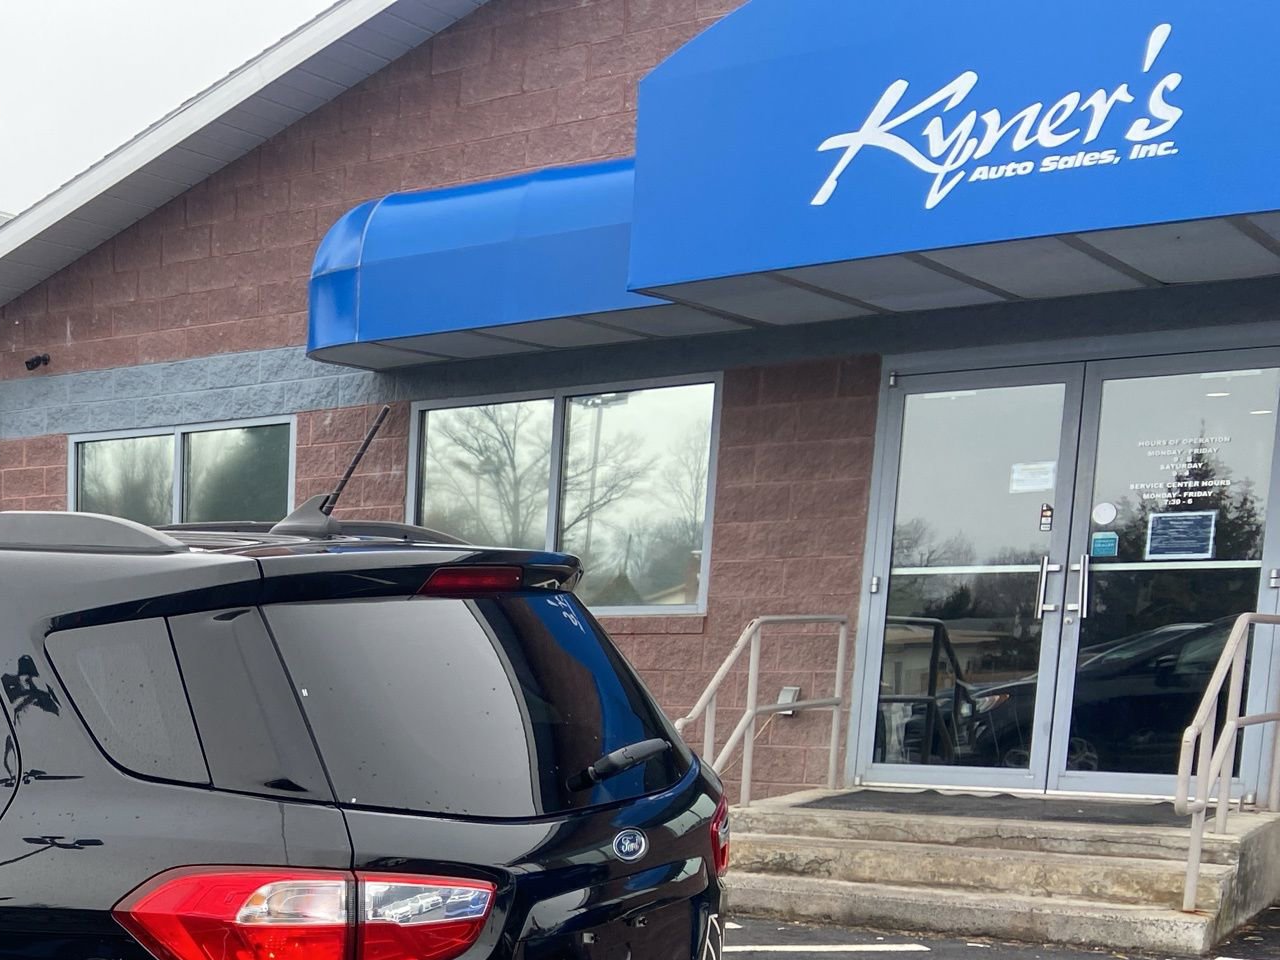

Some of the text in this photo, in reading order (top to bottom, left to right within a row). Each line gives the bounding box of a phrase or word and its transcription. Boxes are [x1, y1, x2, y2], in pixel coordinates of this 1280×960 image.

[810, 22, 1185, 210] Kyner's
[968, 141, 1179, 183] Auto Sales, Inc.
[1138, 439, 1167, 447] HOURS
[1182, 436, 1231, 445] OPERATION
[1188, 447, 1219, 455] FRIDAY
[1166, 480, 1200, 488] CENTER
[1201, 479, 1231, 487] HOURS
[1183, 490, 1213, 498] FRIDAY
